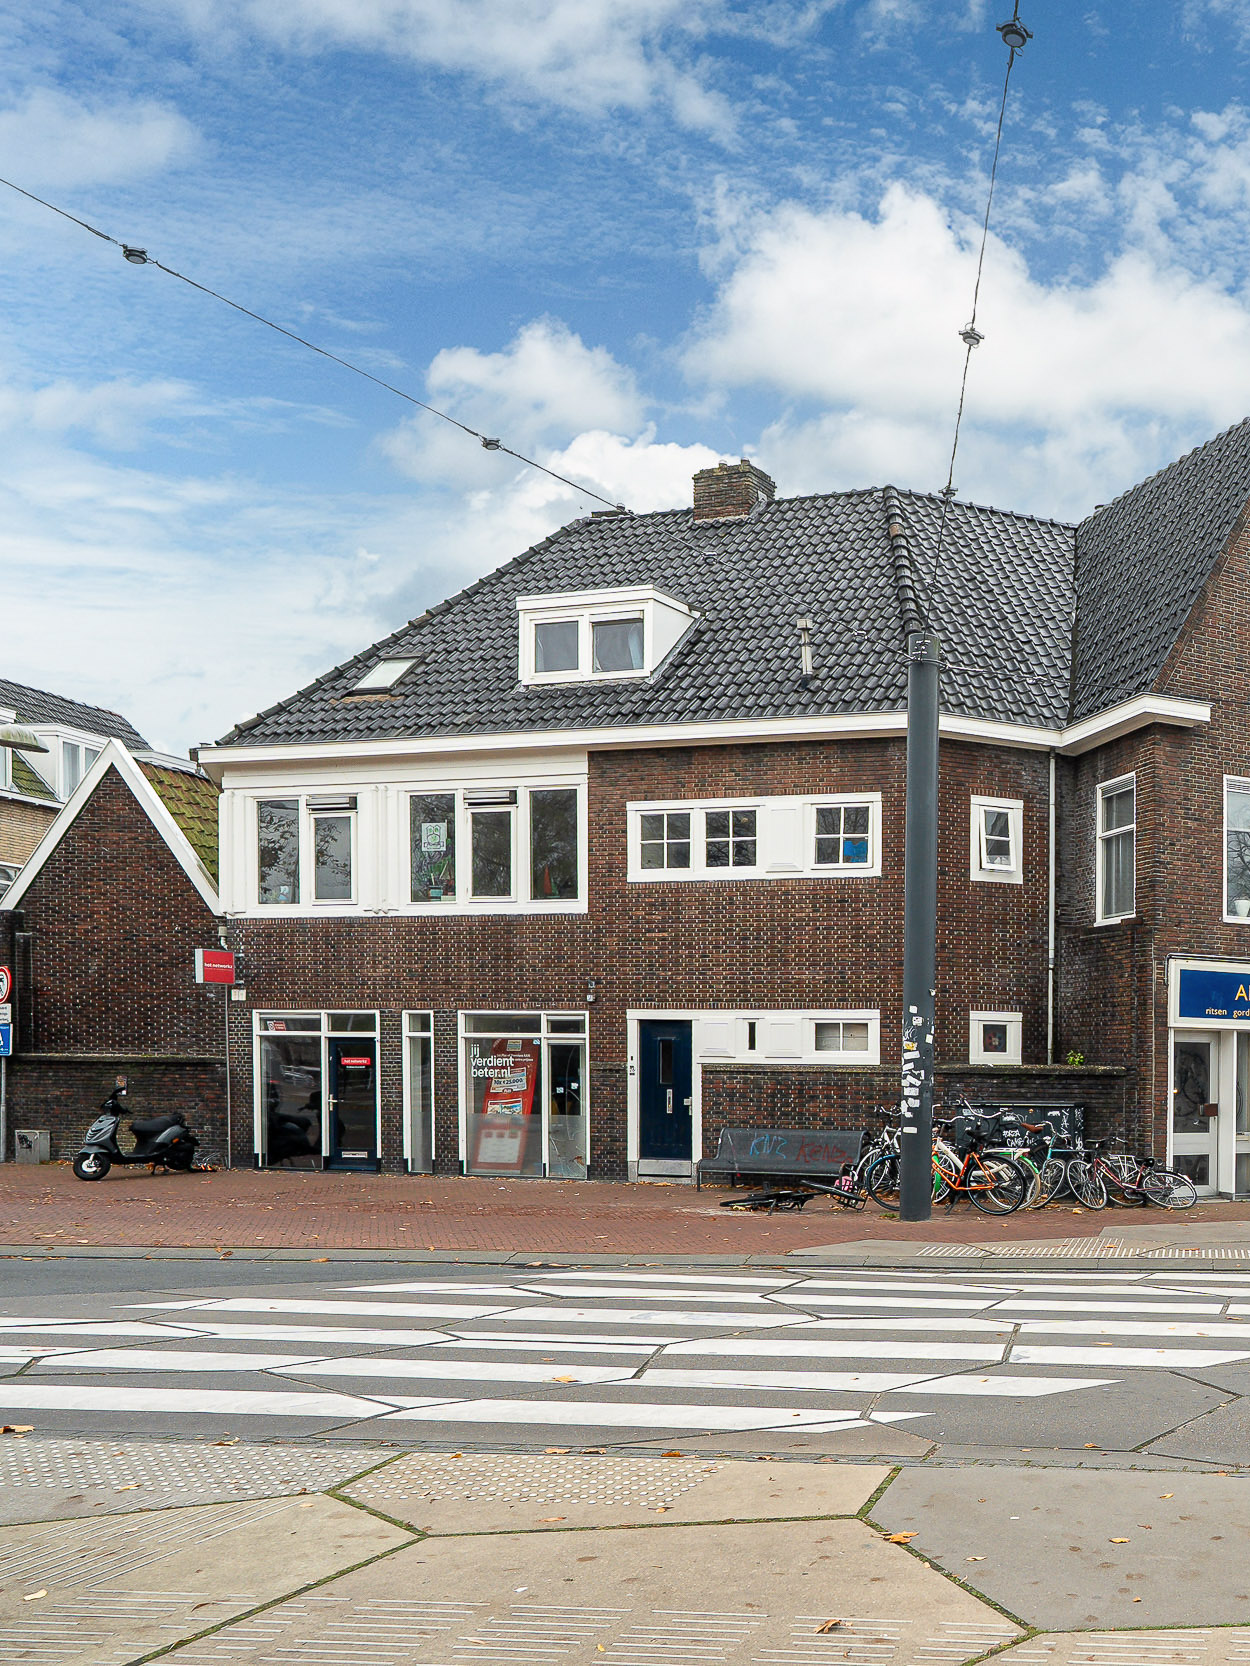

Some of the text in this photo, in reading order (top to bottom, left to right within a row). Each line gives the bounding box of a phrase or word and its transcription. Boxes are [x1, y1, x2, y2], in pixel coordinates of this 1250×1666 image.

[1205, 1007, 1227, 1016] ritsen
[470, 1045, 480, 1057] jij
[470, 1056, 514, 1067] verdient
[471, 1067, 511, 1078] beter.nl
